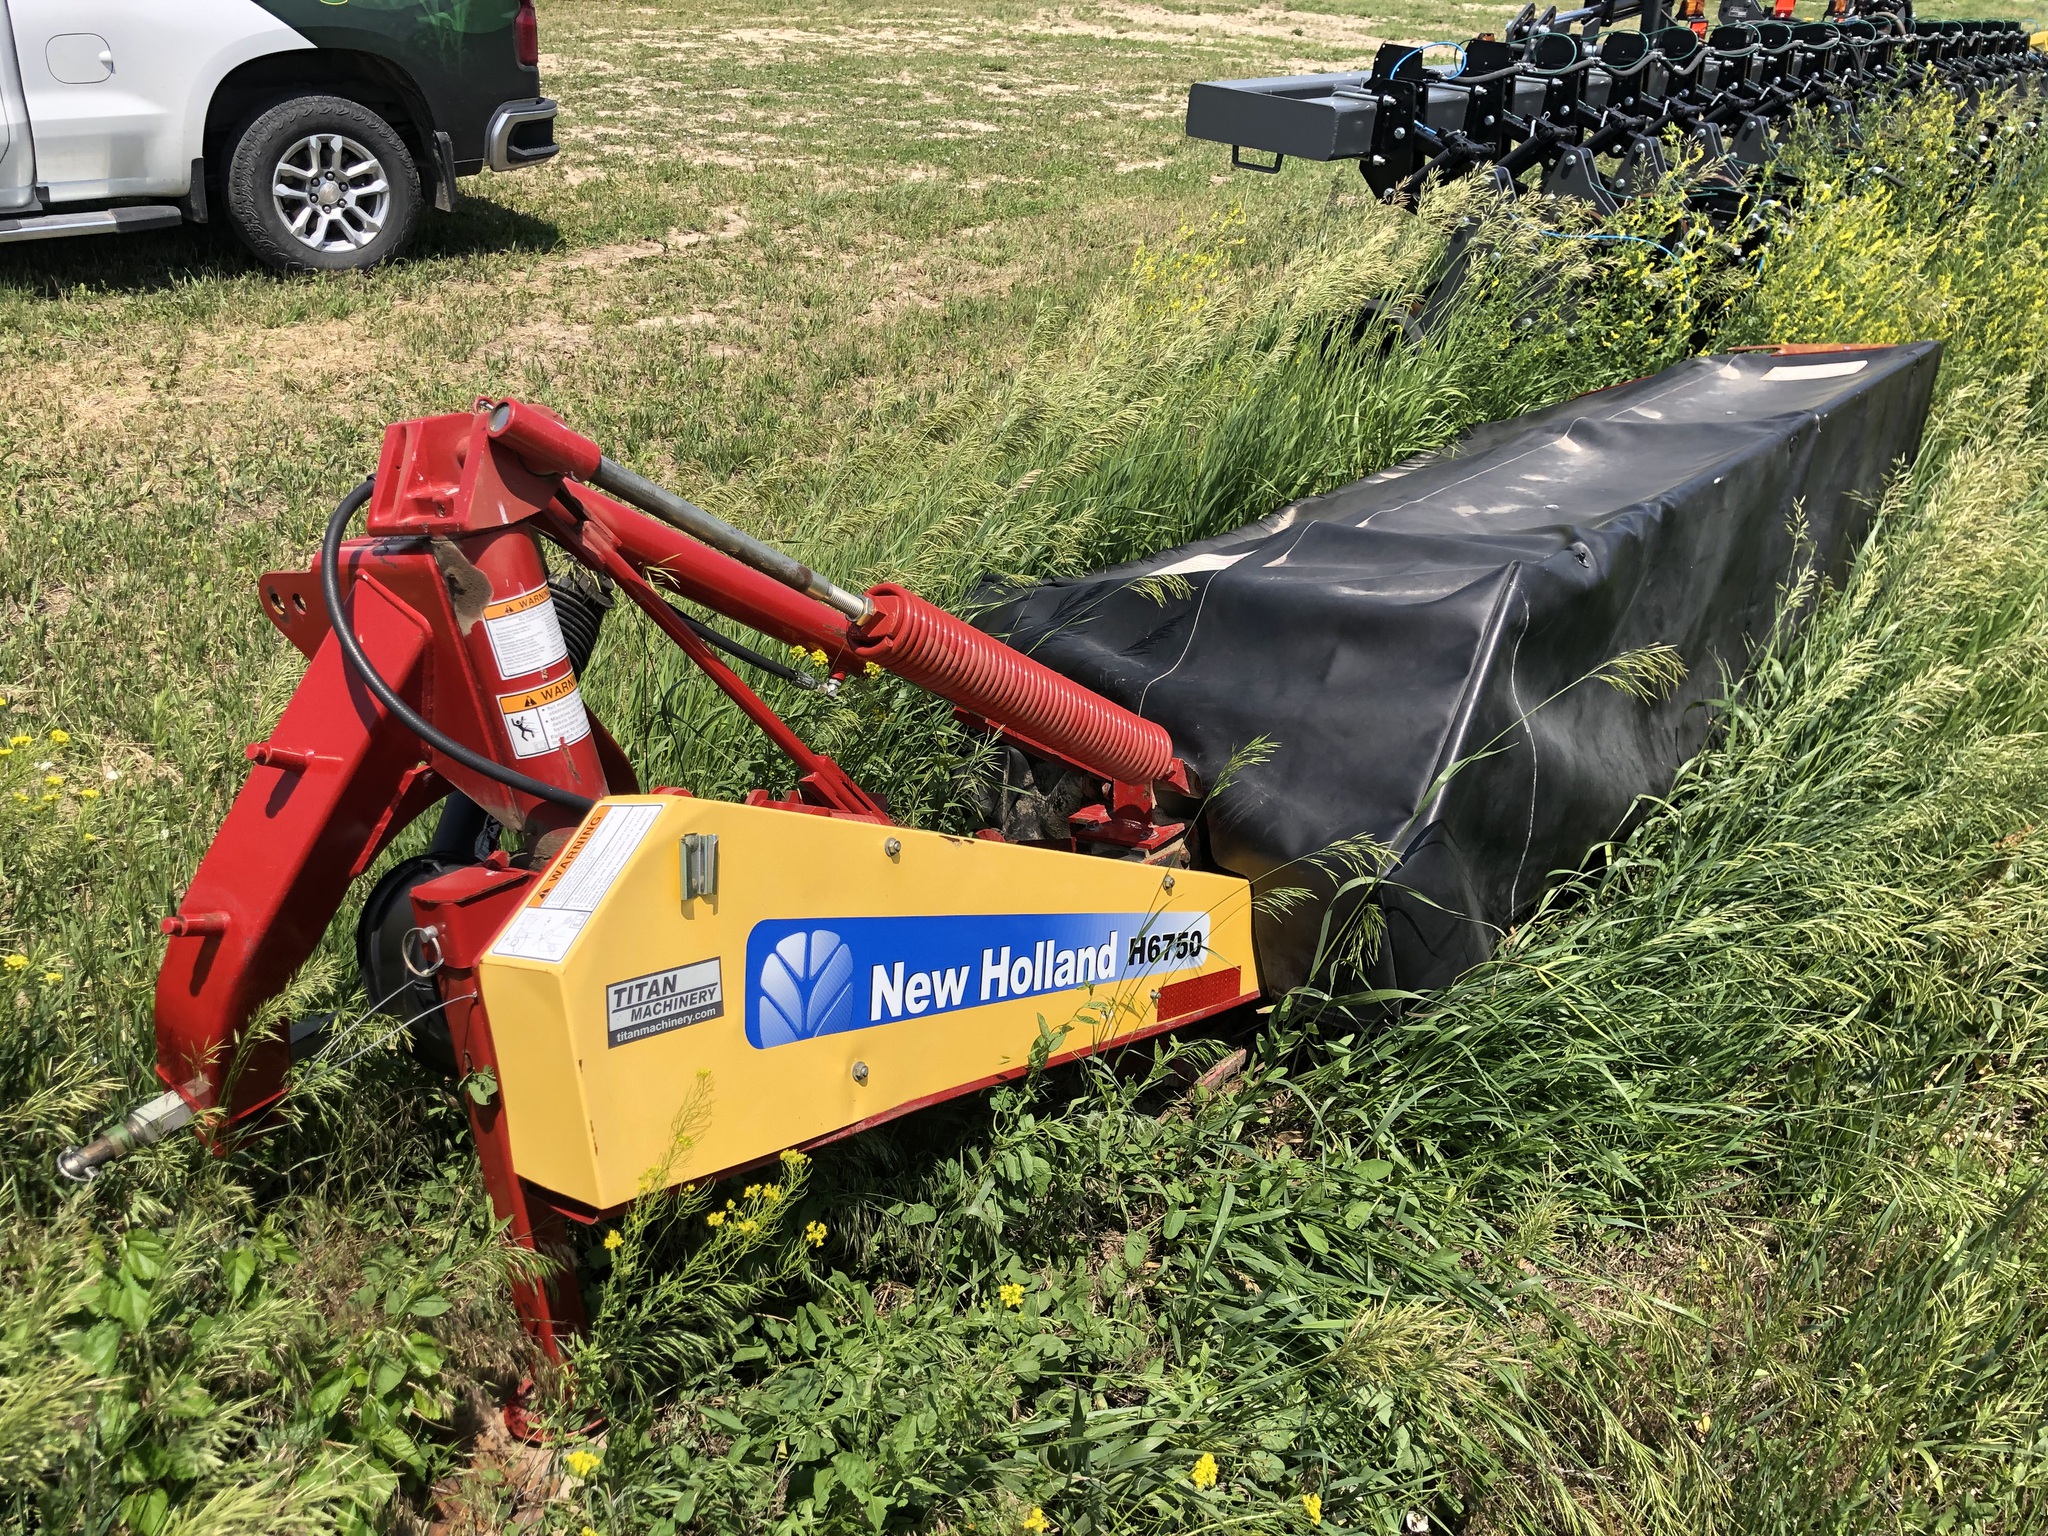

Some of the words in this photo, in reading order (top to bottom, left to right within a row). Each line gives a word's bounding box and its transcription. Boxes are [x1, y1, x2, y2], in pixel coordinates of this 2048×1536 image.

[549, 816, 602, 882] WARNING
[613, 974, 677, 1008] TITAN
[870, 961, 971, 1022] New
[980, 930, 1119, 1001] Holland
[1128, 930, 1202, 966] H6750
[630, 987, 717, 1022] MACHINERY
[616, 1007, 716, 1042] titanmachinery.com
